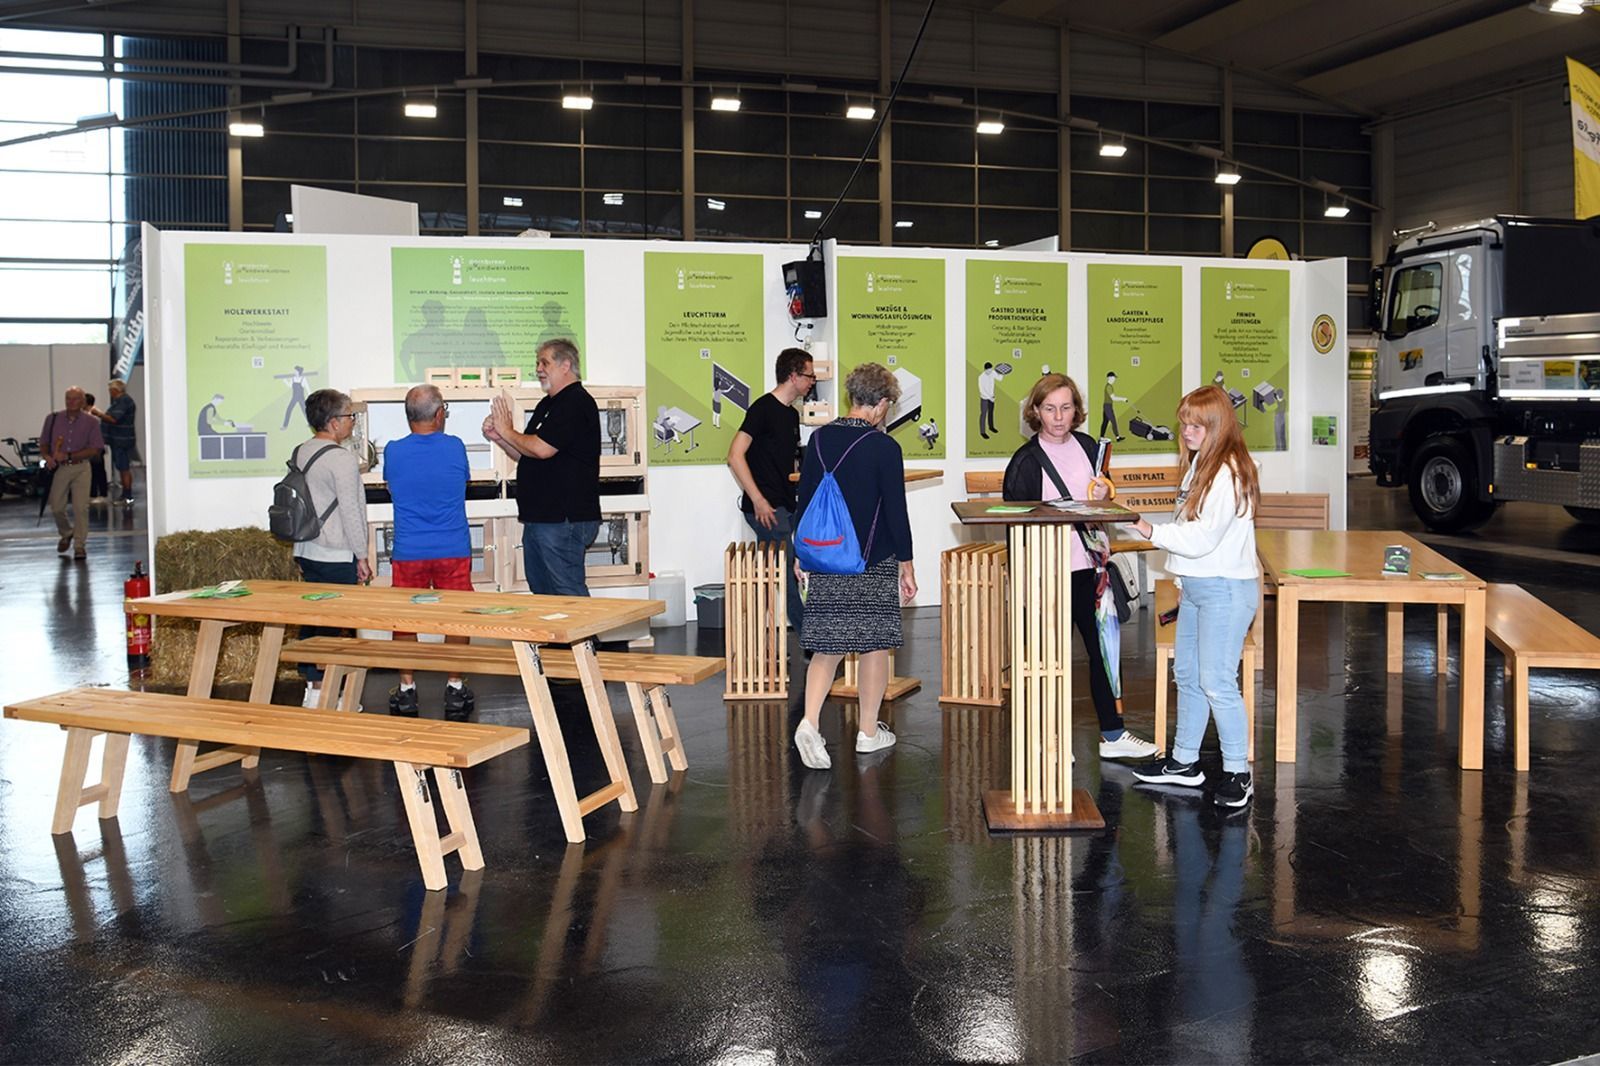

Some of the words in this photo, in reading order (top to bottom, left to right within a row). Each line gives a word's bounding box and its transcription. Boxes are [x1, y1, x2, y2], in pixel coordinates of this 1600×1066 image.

[224, 308, 290, 316] HOLZWERKSTATT
[876, 304, 902, 313] UMZÜGE
[990, 306, 1015, 314] GASTRO
[1016, 307, 1039, 315] SERVICE
[682, 311, 727, 319] LEUCHTTURM
[851, 312, 932, 321] WOHNUNGSAUFLÖSUNGEN
[988, 314, 1047, 323] PRODUKTIONSKÜCHE
[1122, 473, 1141, 482] KEIN
[1142, 472, 1165, 481] PLATZ
[1126, 496, 1141, 507] FÜR
